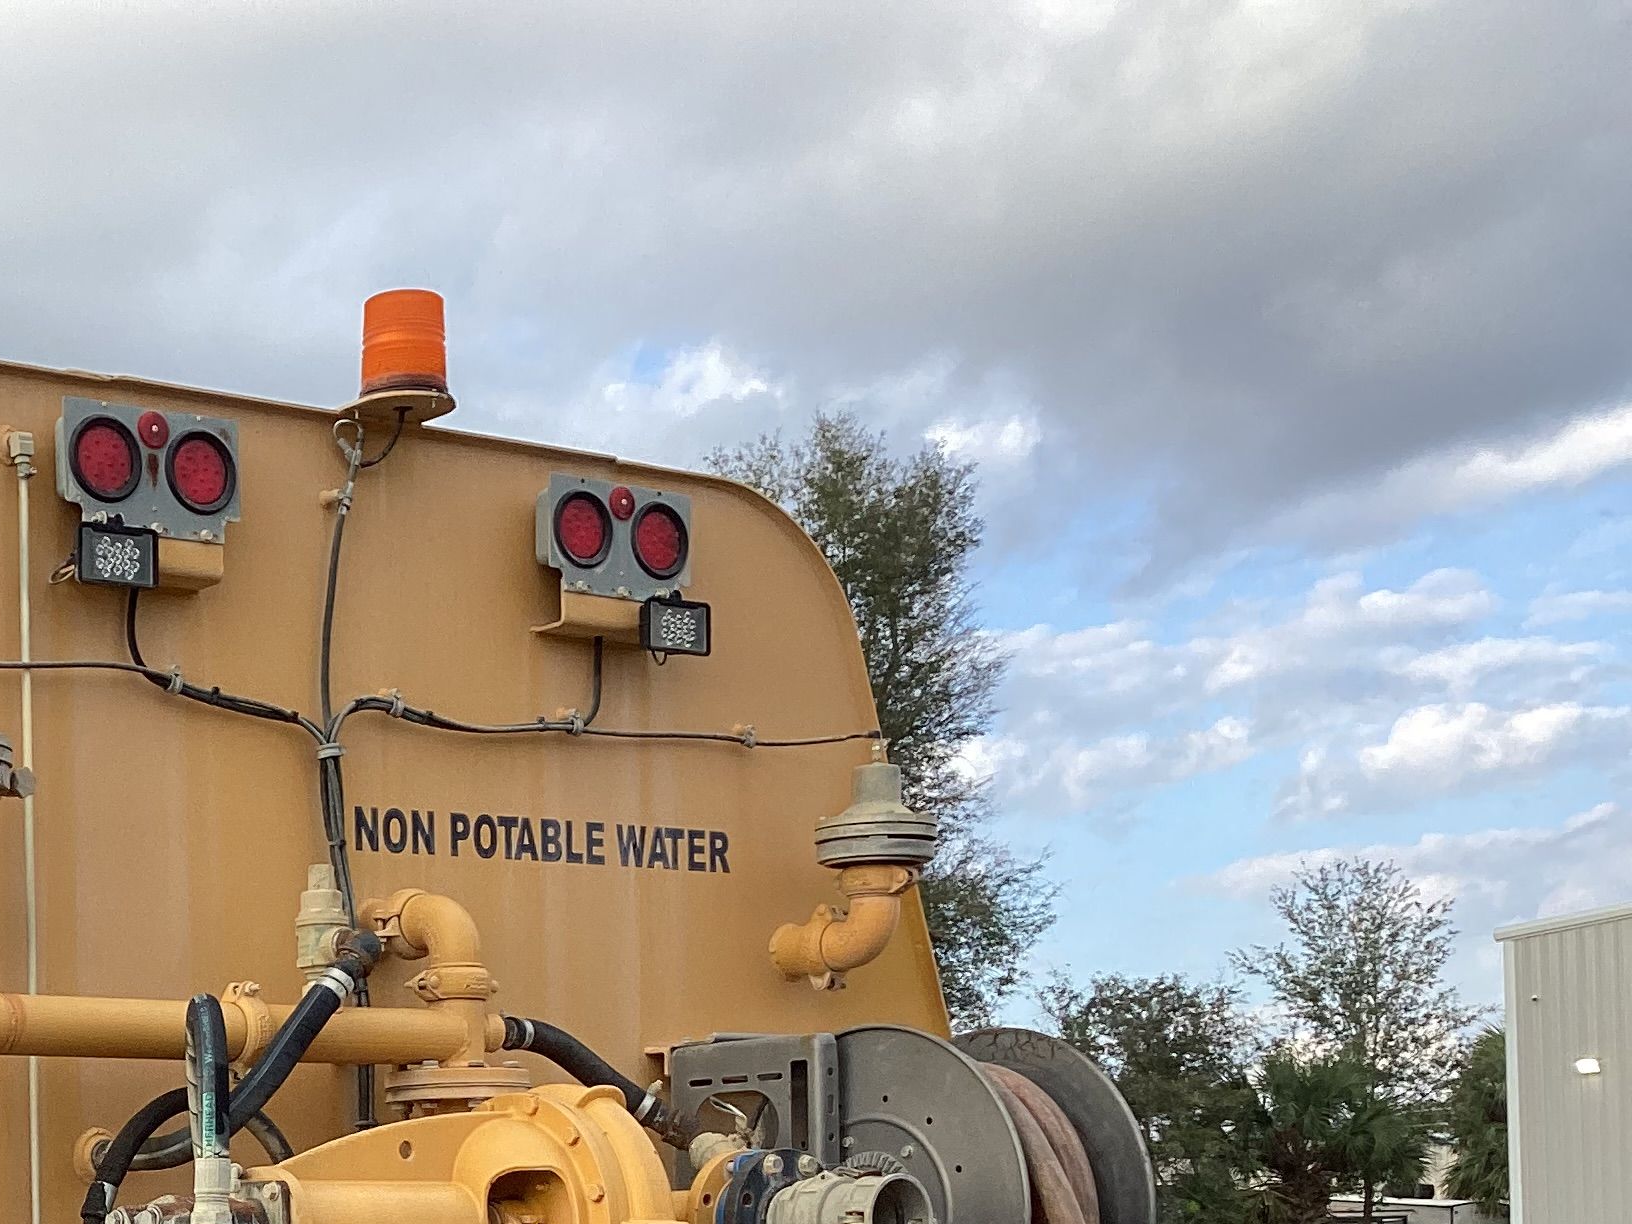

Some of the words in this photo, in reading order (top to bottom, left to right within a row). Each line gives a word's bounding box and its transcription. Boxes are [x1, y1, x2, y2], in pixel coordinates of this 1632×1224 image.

[354, 806, 435, 855] NON
[450, 812, 605, 865] POTABLE
[616, 824, 731, 873] WATER
